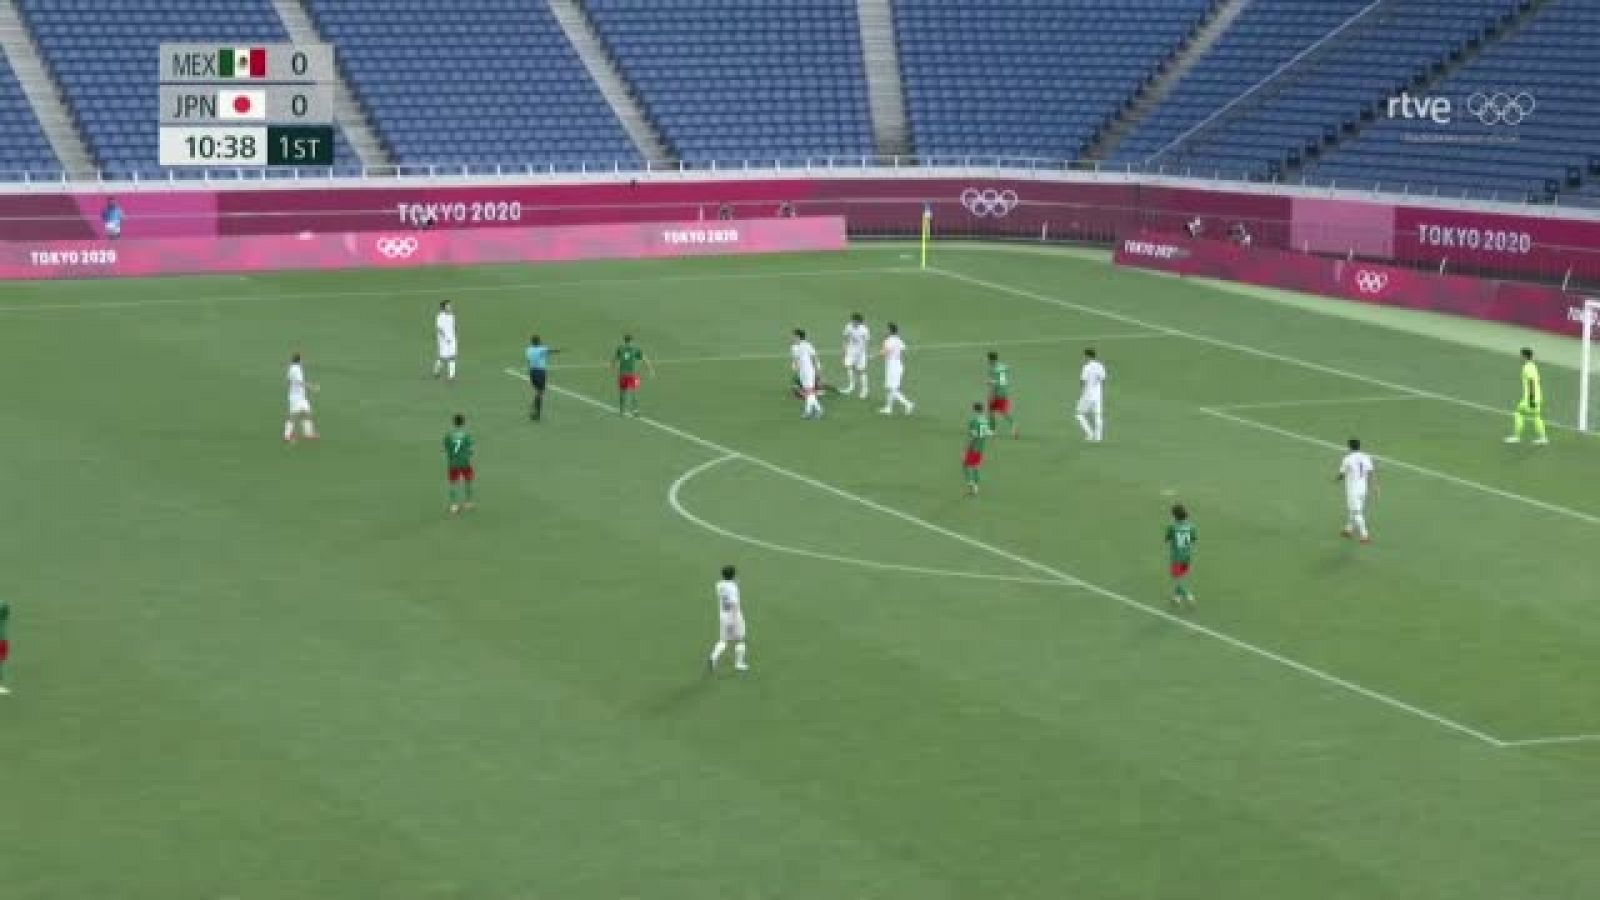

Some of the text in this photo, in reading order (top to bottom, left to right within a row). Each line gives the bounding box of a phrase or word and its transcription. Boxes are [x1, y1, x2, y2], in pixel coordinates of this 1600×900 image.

[471, 201, 521, 221] 2020
[663, 229, 738, 244] TOKYO 2020
[1419, 224, 1531, 254] TOKYO 2020
[30, 250, 117, 266] TOKYO 2020
[452, 439, 461, 454] 7
